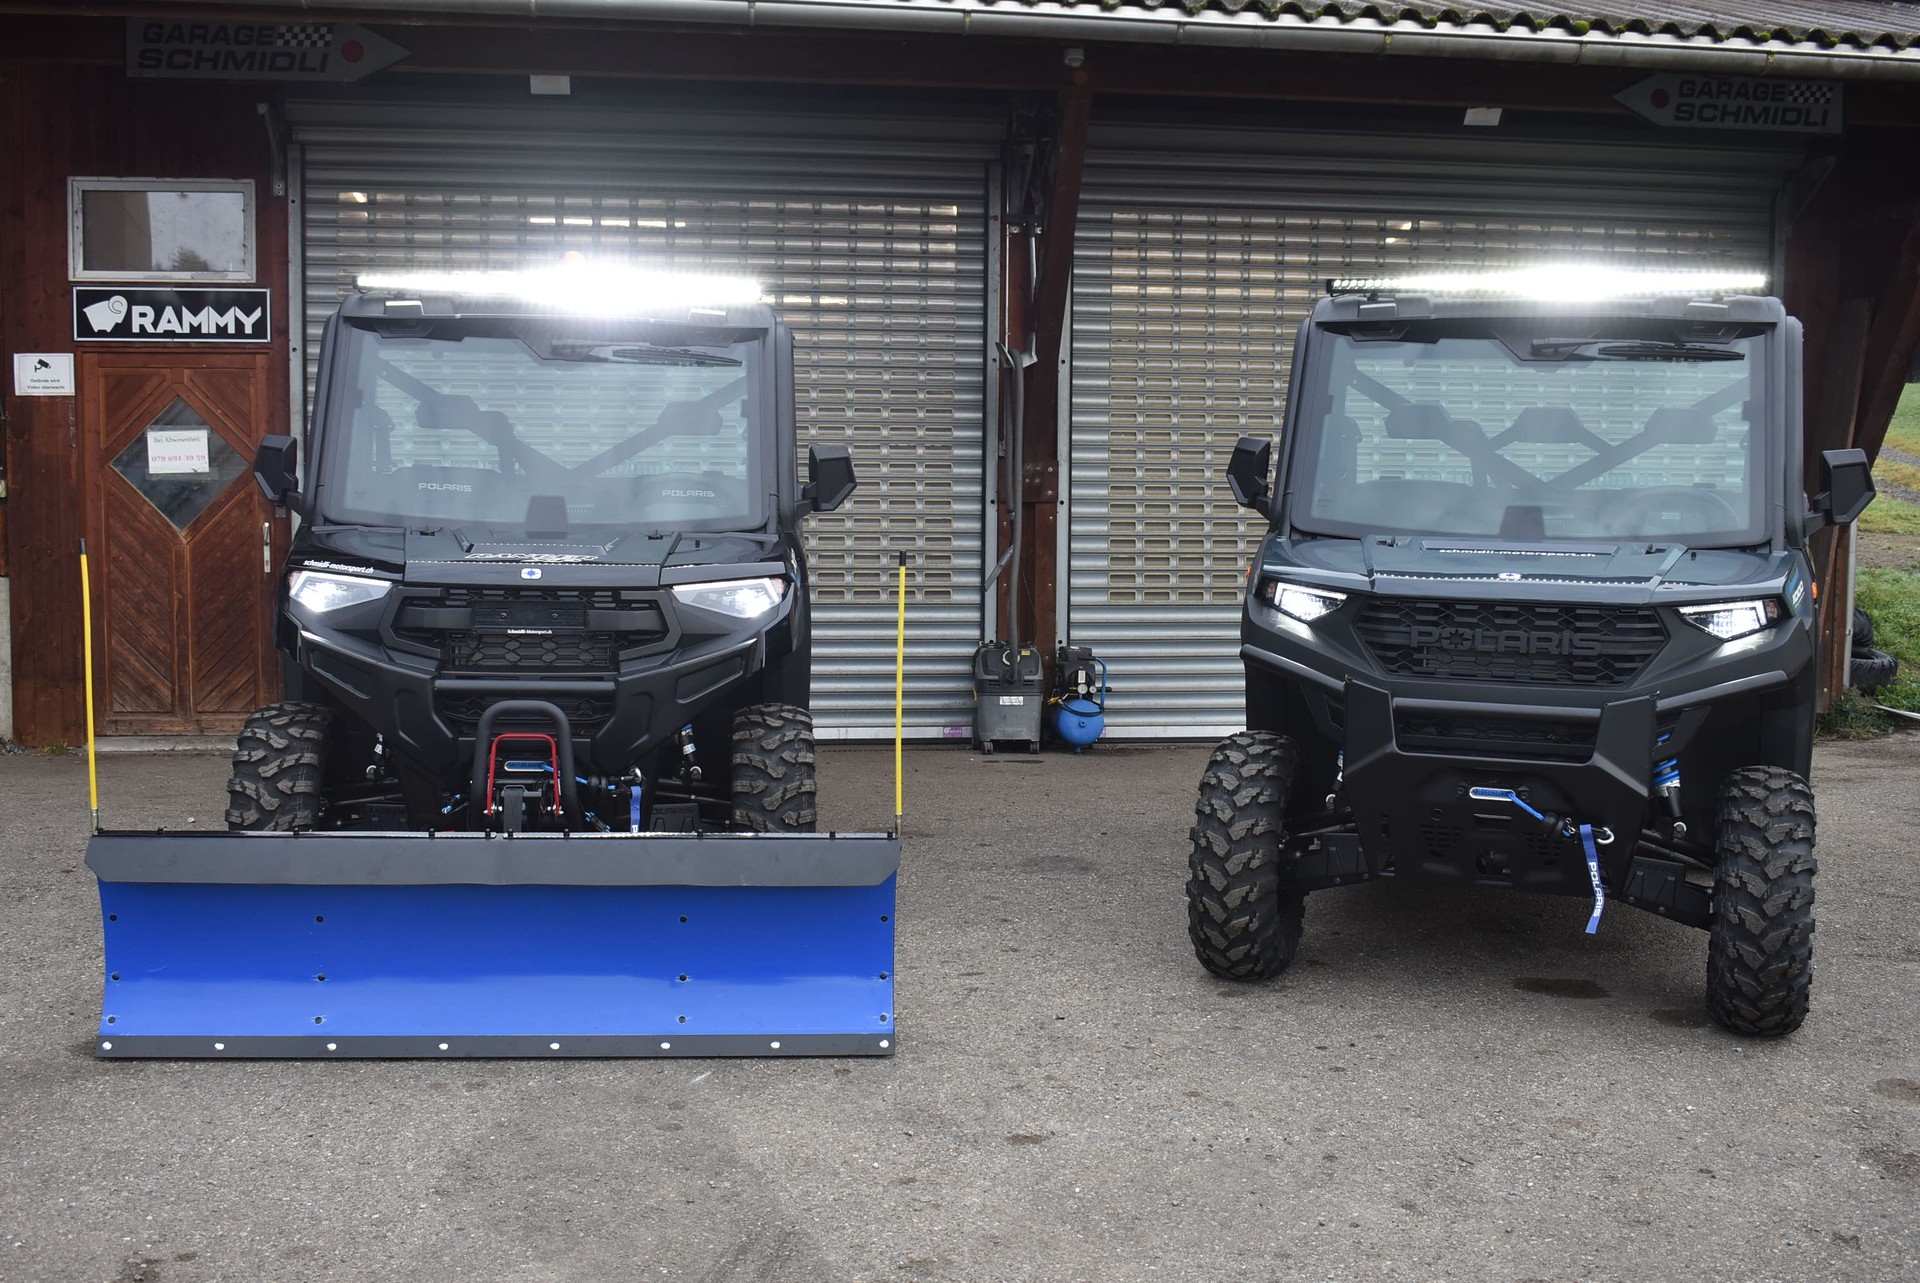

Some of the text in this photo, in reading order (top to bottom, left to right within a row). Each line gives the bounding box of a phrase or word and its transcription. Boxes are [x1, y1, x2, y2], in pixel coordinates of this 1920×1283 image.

[143, 23, 275, 46] GARAGE
[137, 48, 329, 73] SCHMIDLI
[1678, 79, 1787, 102] GARAGE
[1673, 102, 1829, 127] SCHMIDLI
[131, 305, 262, 334] RAMMY
[418, 482, 473, 492] POLARIS
[661, 489, 715, 498] POLARIS
[1438, 548, 1596, 558] schmidli-motorsport.ch
[303, 559, 375, 574] schmidli-motorsport.ch
[1410, 625, 1601, 656] POLARIS
[1588, 861, 1604, 917] POLARIS
